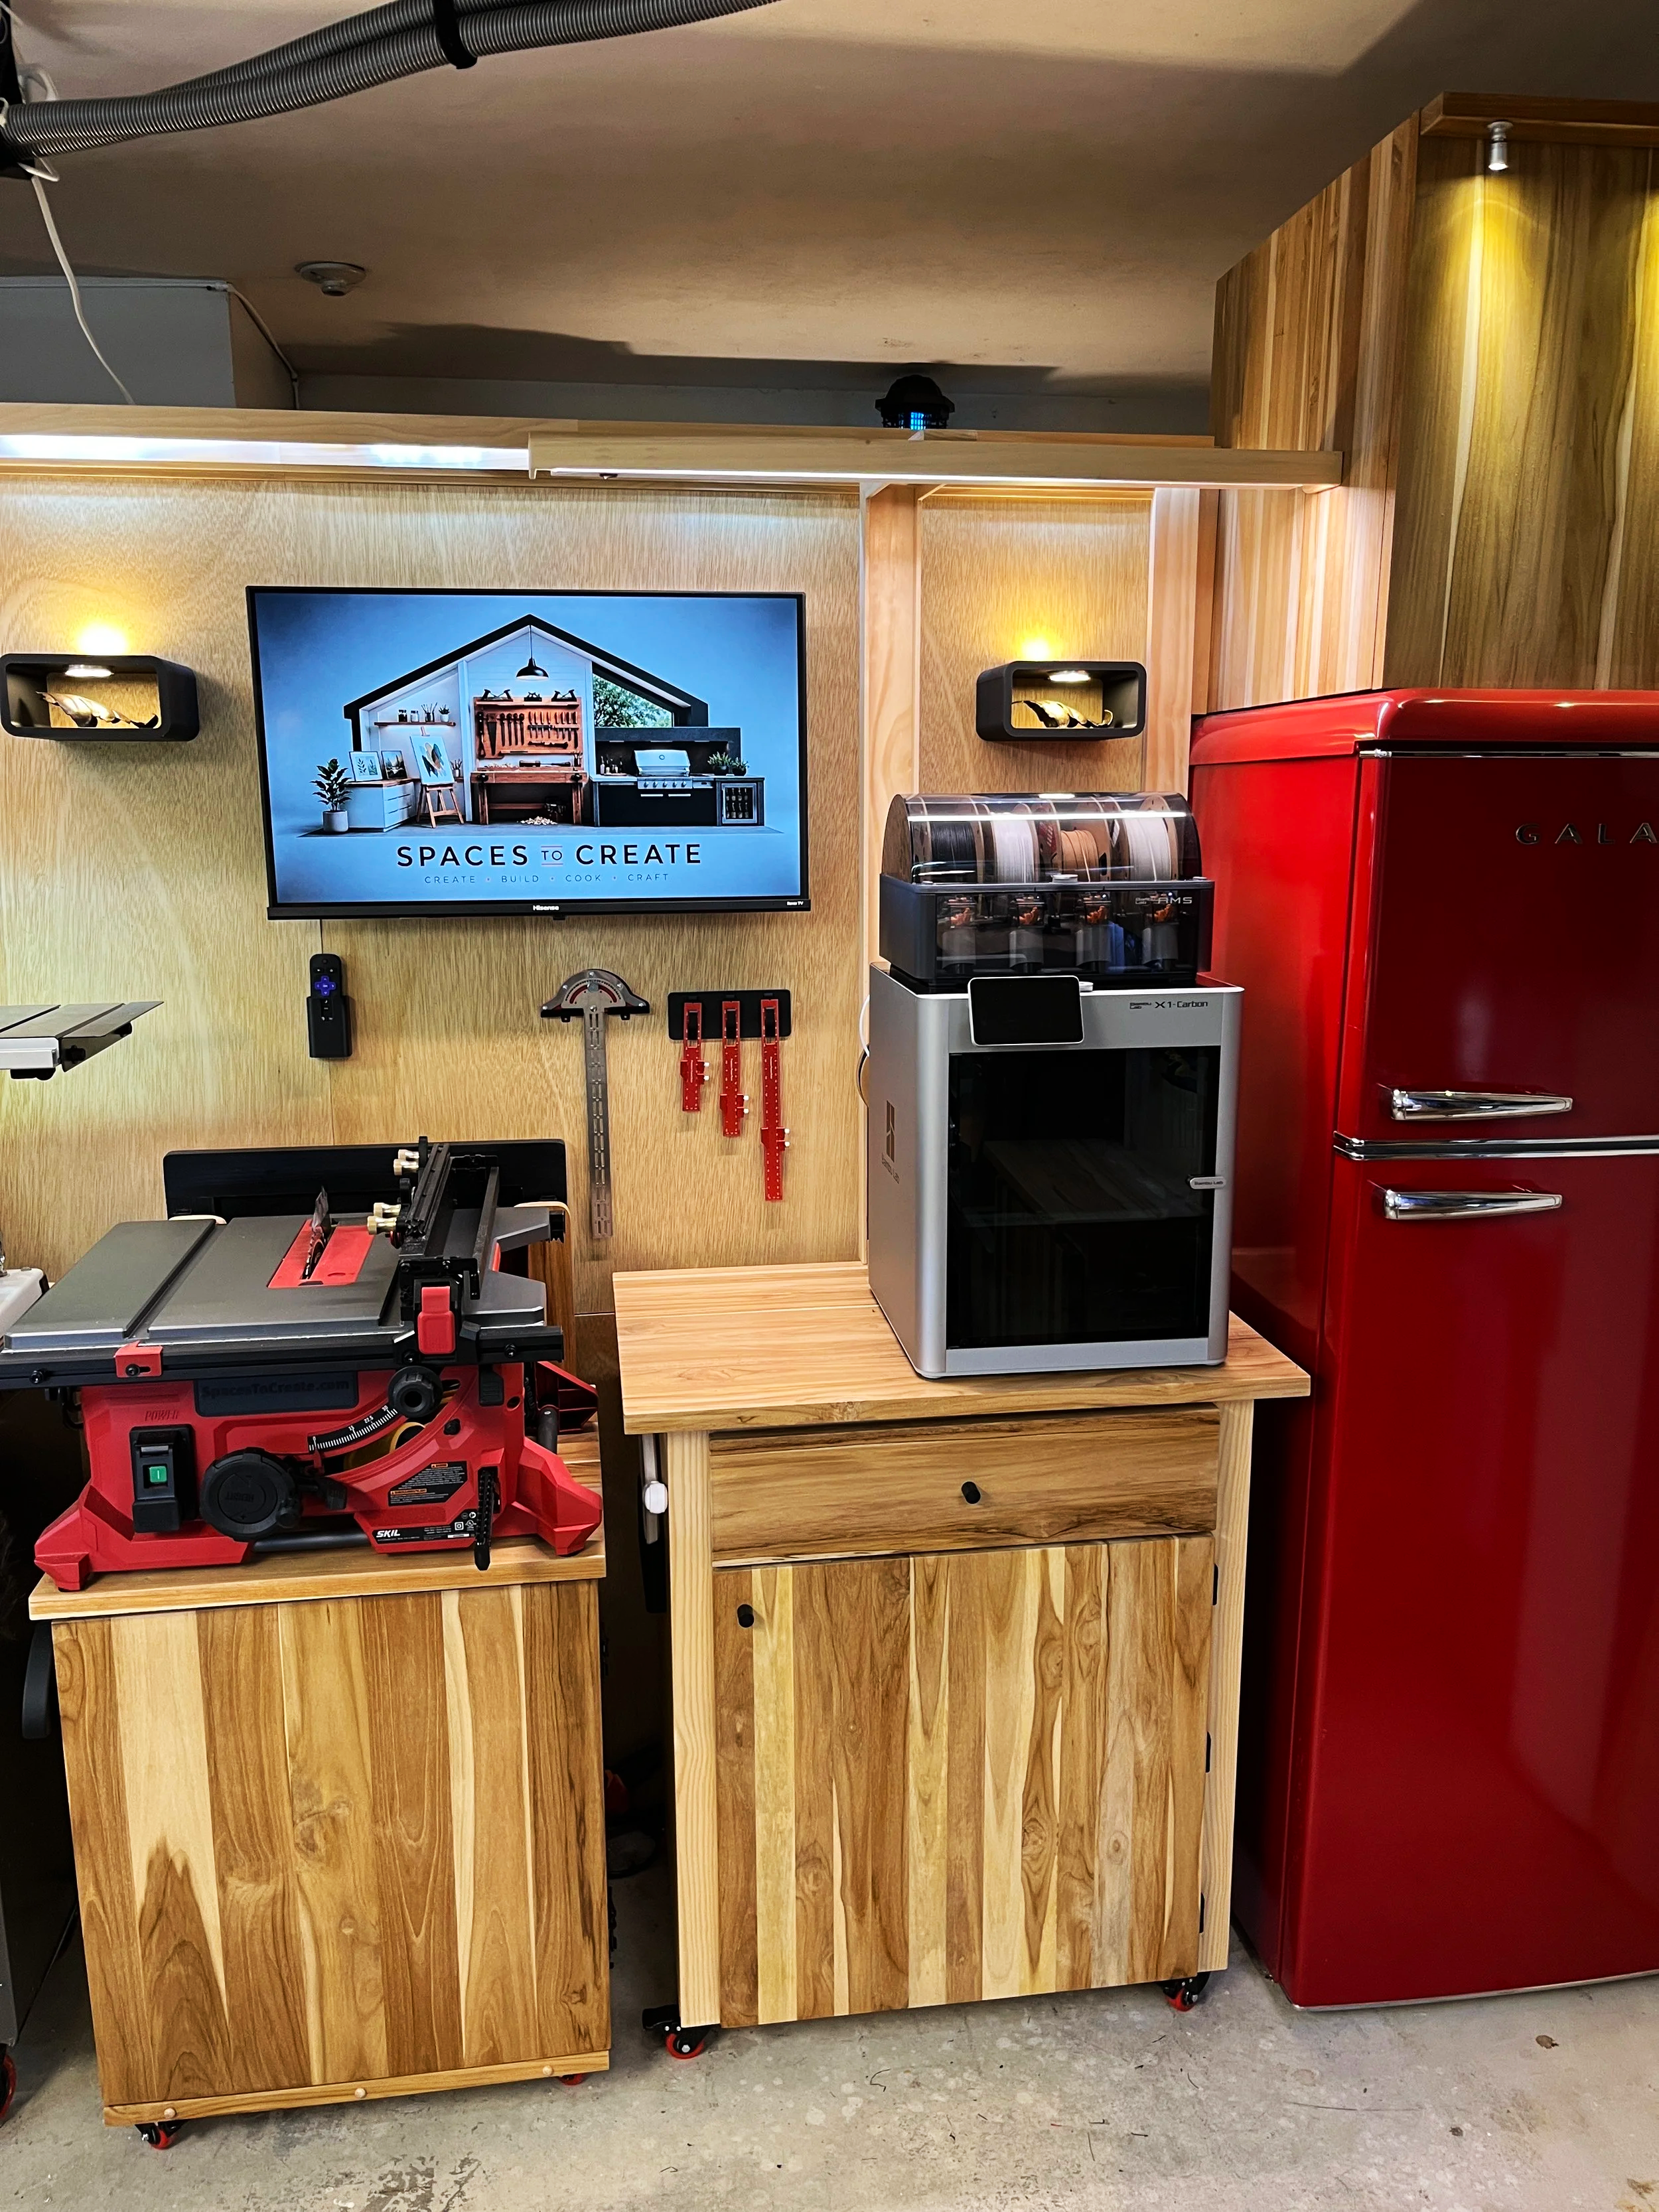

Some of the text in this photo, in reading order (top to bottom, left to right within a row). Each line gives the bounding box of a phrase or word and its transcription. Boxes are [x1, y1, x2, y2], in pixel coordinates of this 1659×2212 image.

[1516, 822, 1659, 845] GALA
[397, 844, 701, 867] SPACES TO CREATE
[364, 1415, 374, 1424] 22.5
[376, 1529, 401, 1538] SKIL
